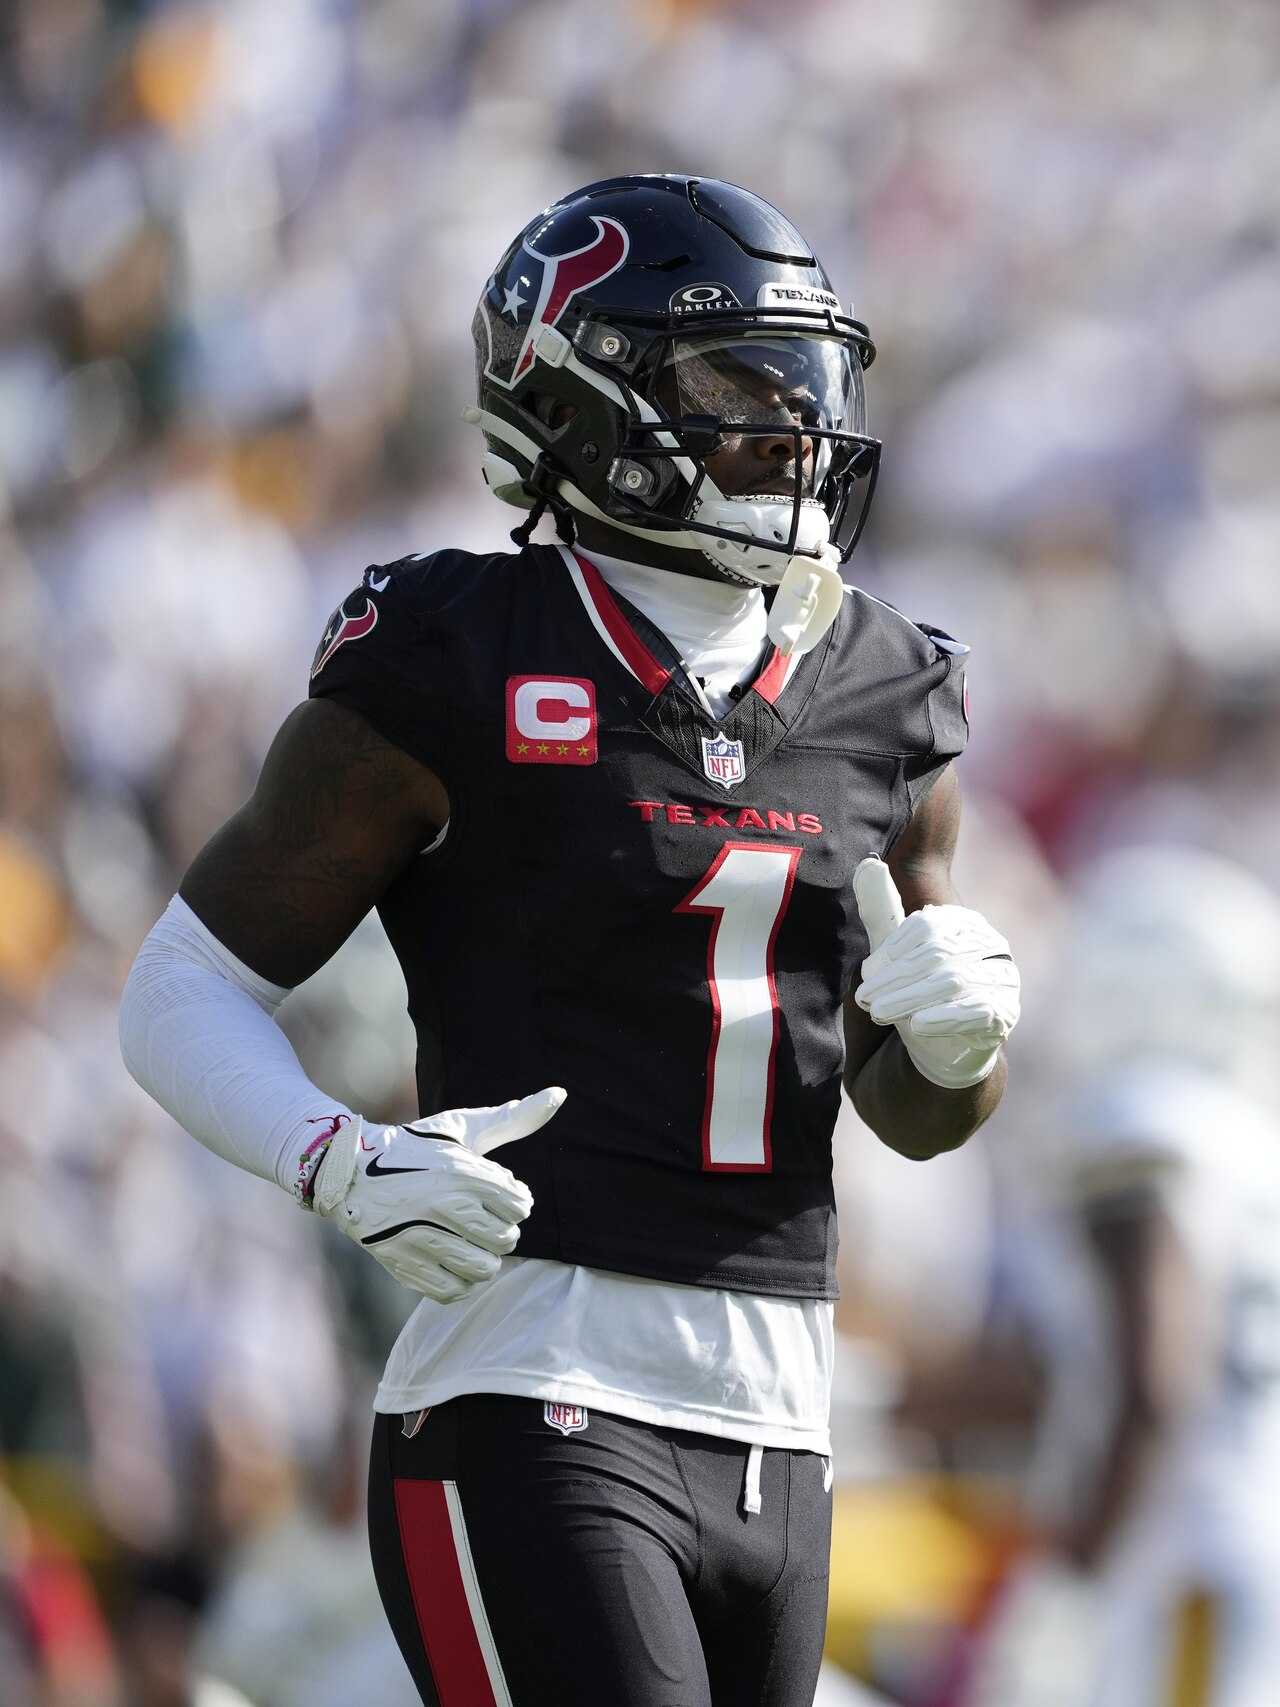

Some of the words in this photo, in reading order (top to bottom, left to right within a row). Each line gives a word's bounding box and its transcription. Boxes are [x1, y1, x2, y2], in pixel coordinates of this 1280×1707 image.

[771, 288, 838, 308] TEXANS
[514, 681, 591, 742] C
[710, 757, 739, 778] NFL
[626, 801, 823, 834] TEXANS
[672, 841, 803, 1173] 1
[551, 1403, 580, 1425] NFL
